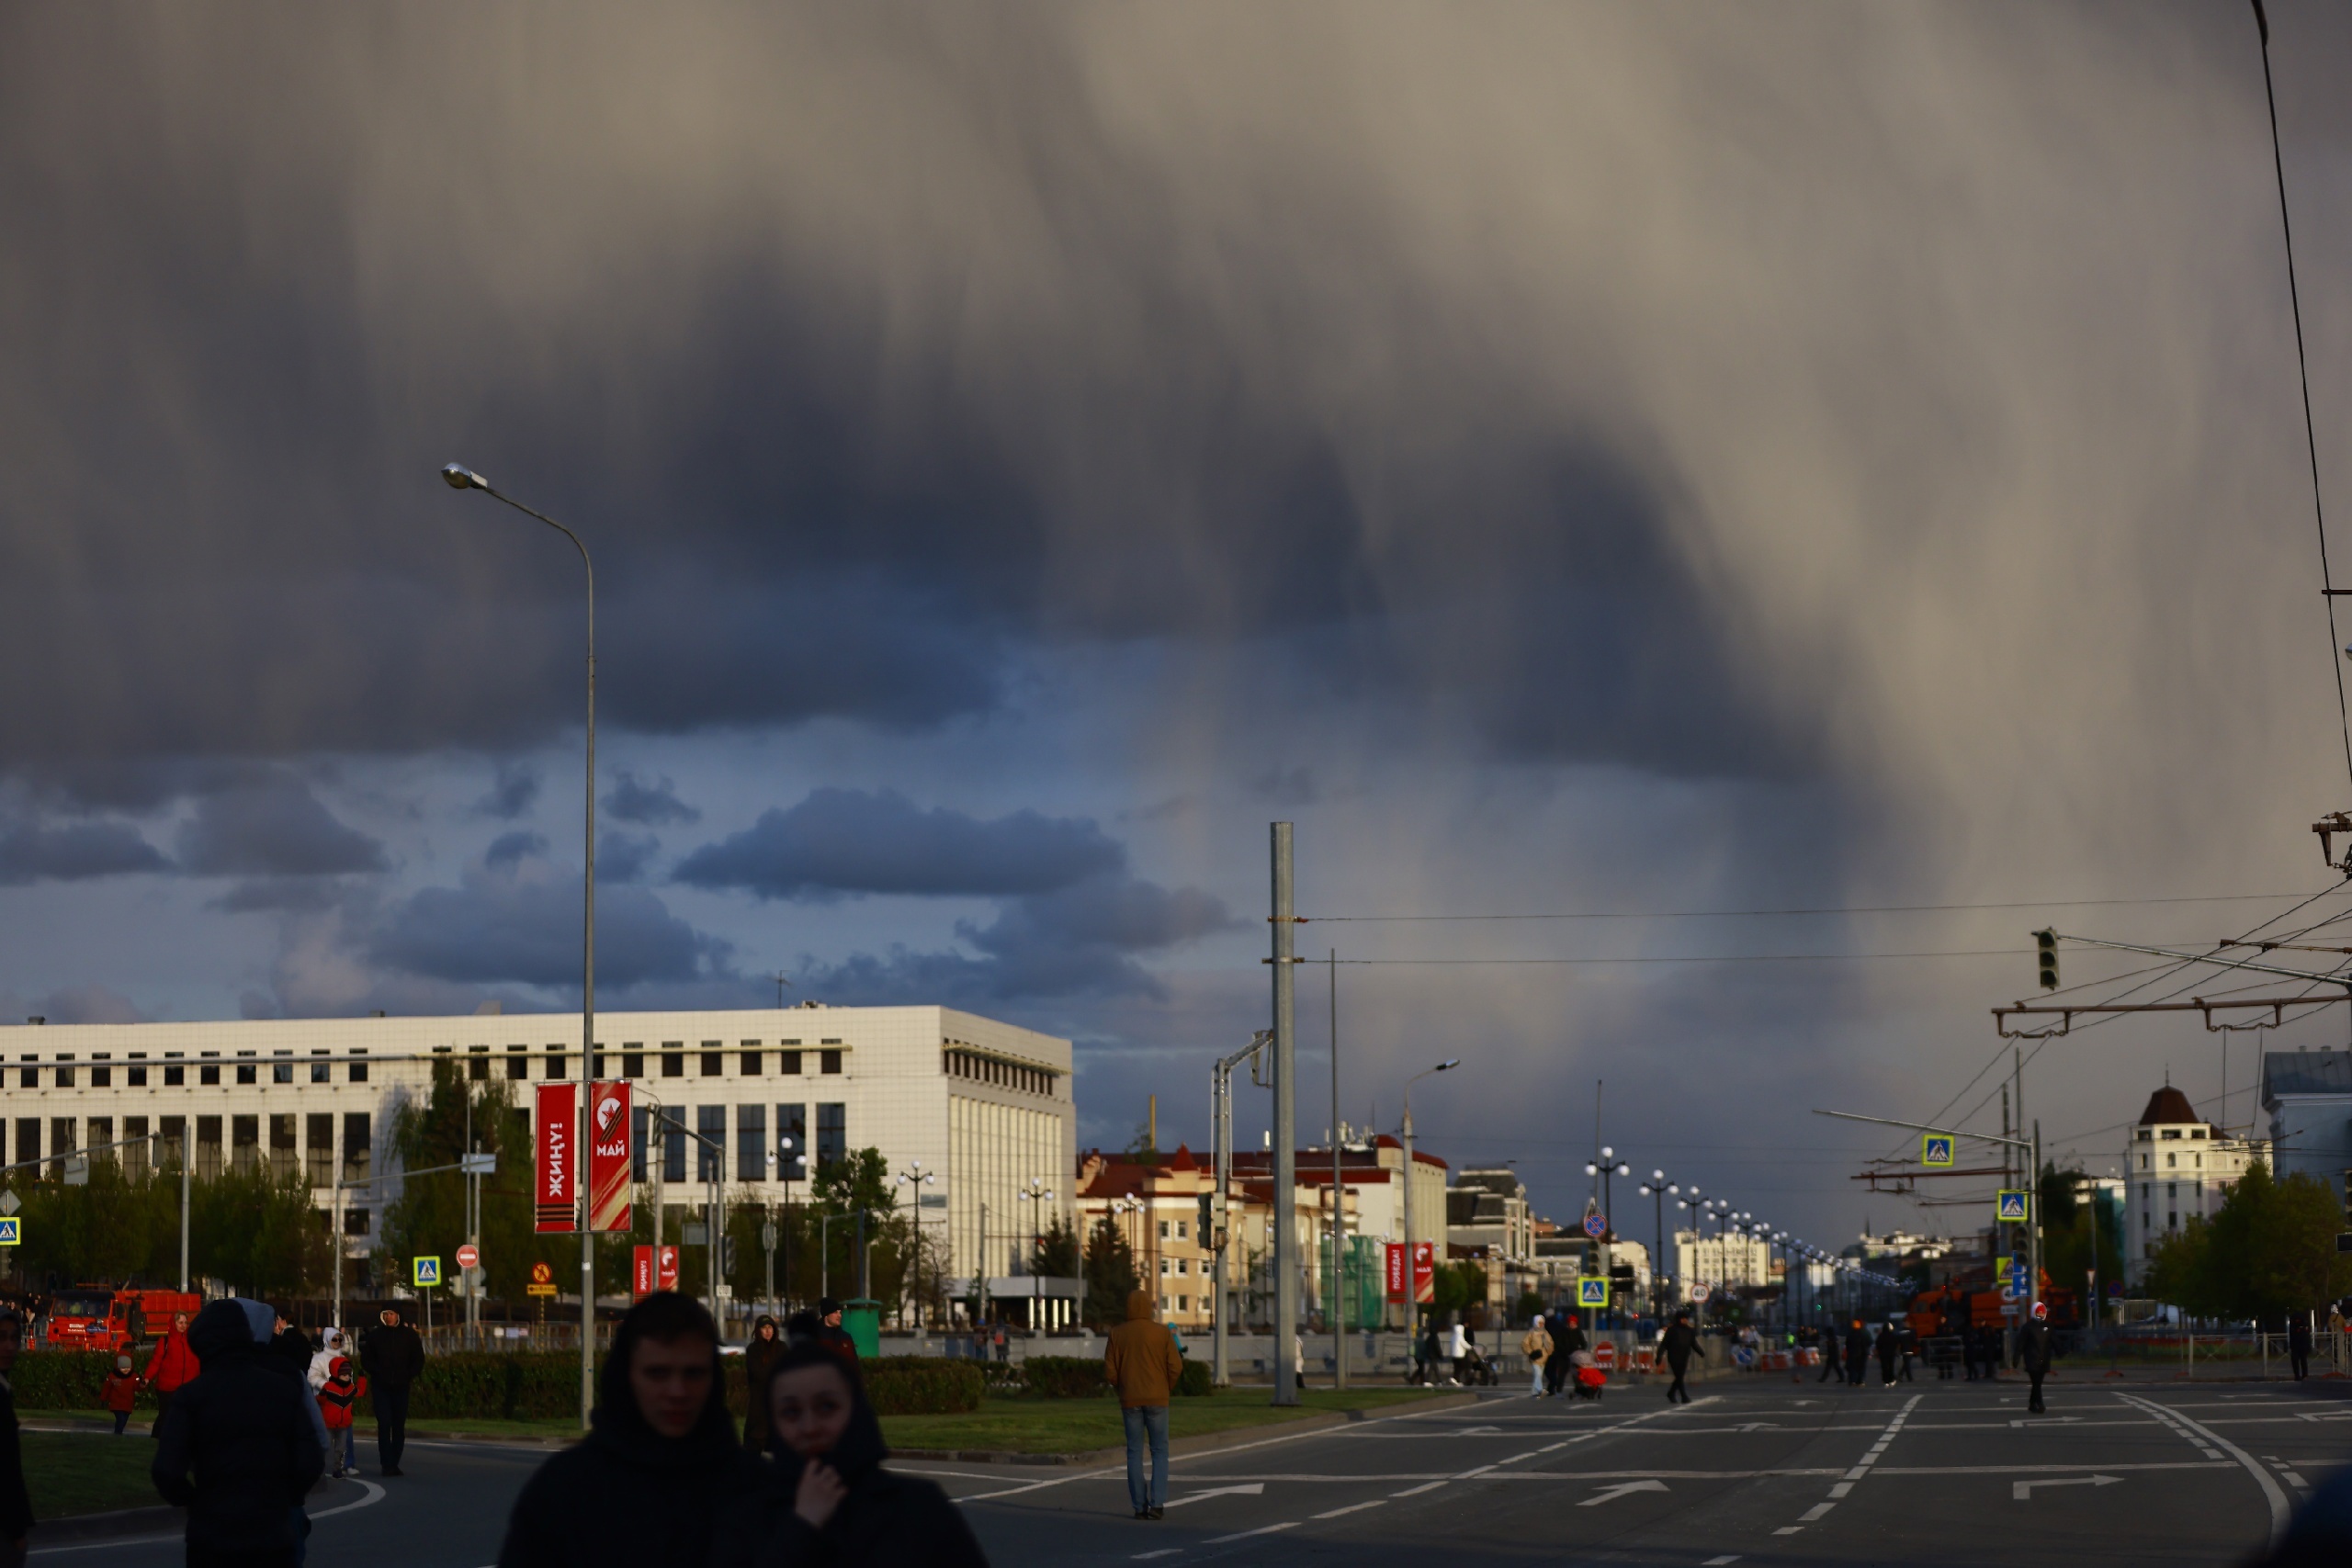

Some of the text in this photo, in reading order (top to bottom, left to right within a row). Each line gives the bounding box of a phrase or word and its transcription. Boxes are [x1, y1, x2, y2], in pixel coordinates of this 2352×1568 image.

[597, 1139, 625, 1156] МАЙ
[1392, 1249, 1401, 1290] ПОБЕДА!
[1694, 1288, 1705, 1297] 40
